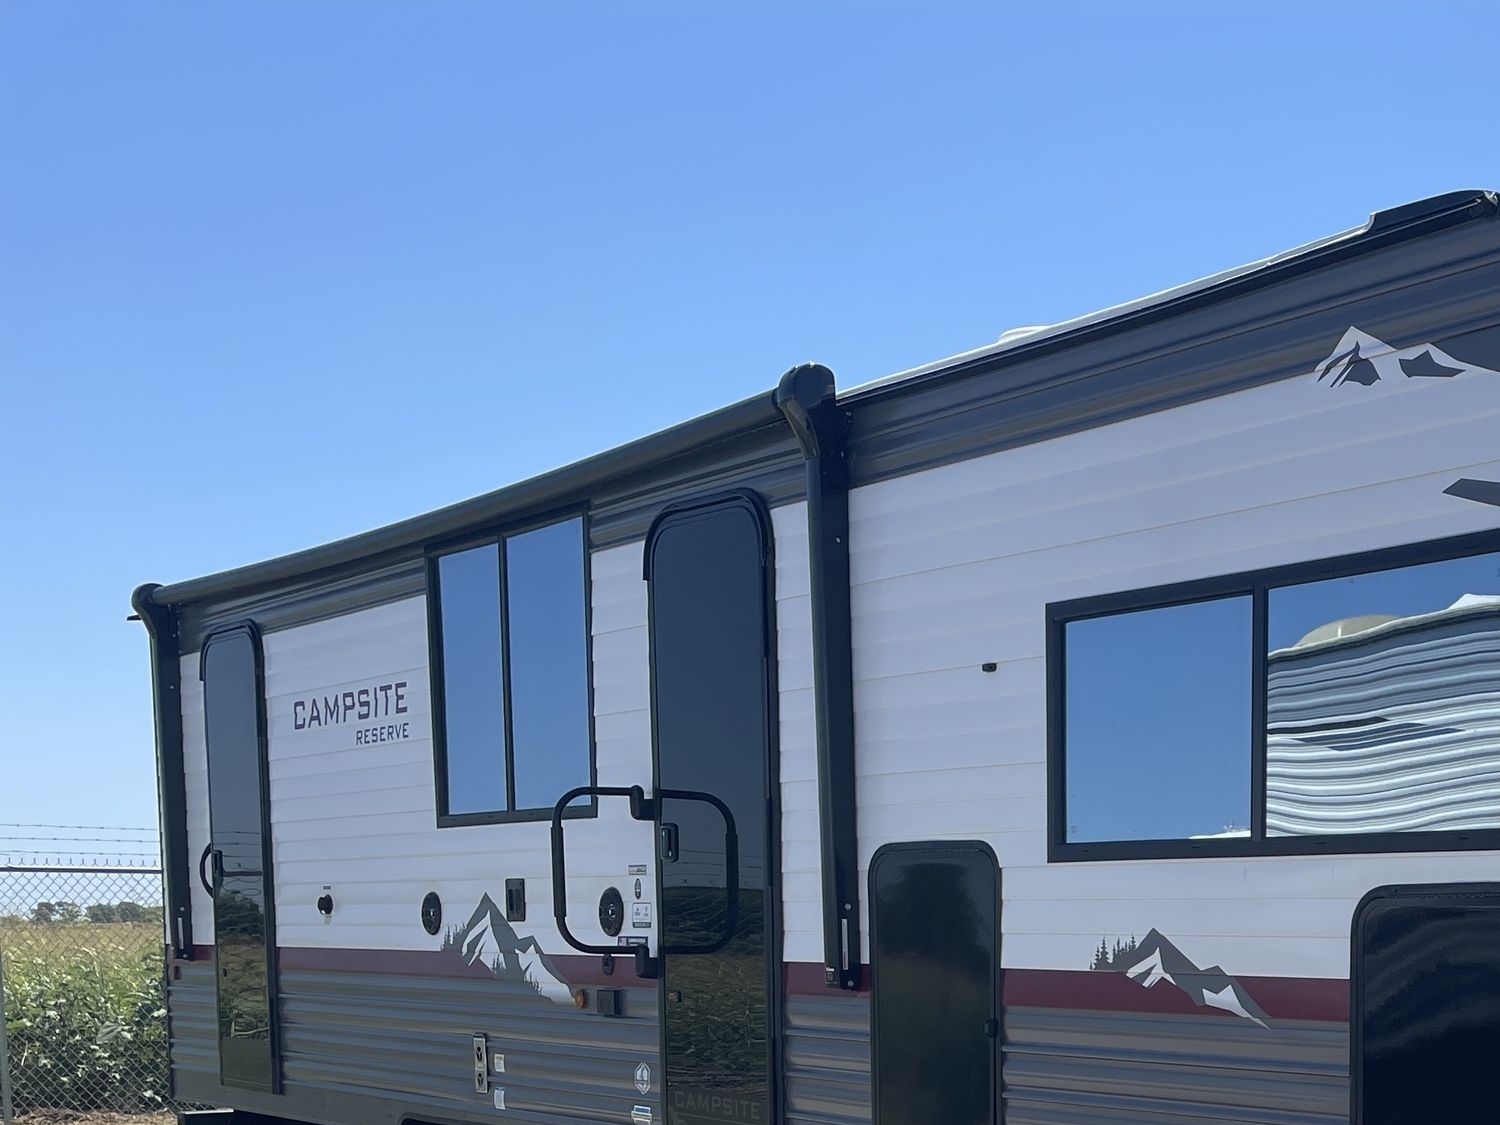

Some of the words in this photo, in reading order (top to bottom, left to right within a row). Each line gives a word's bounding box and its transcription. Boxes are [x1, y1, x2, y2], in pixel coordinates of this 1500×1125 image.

[293, 681, 408, 730] CAMPSITE
[355, 722, 410, 745] RESERVE
[674, 1090, 761, 1120] CAMPSITE
